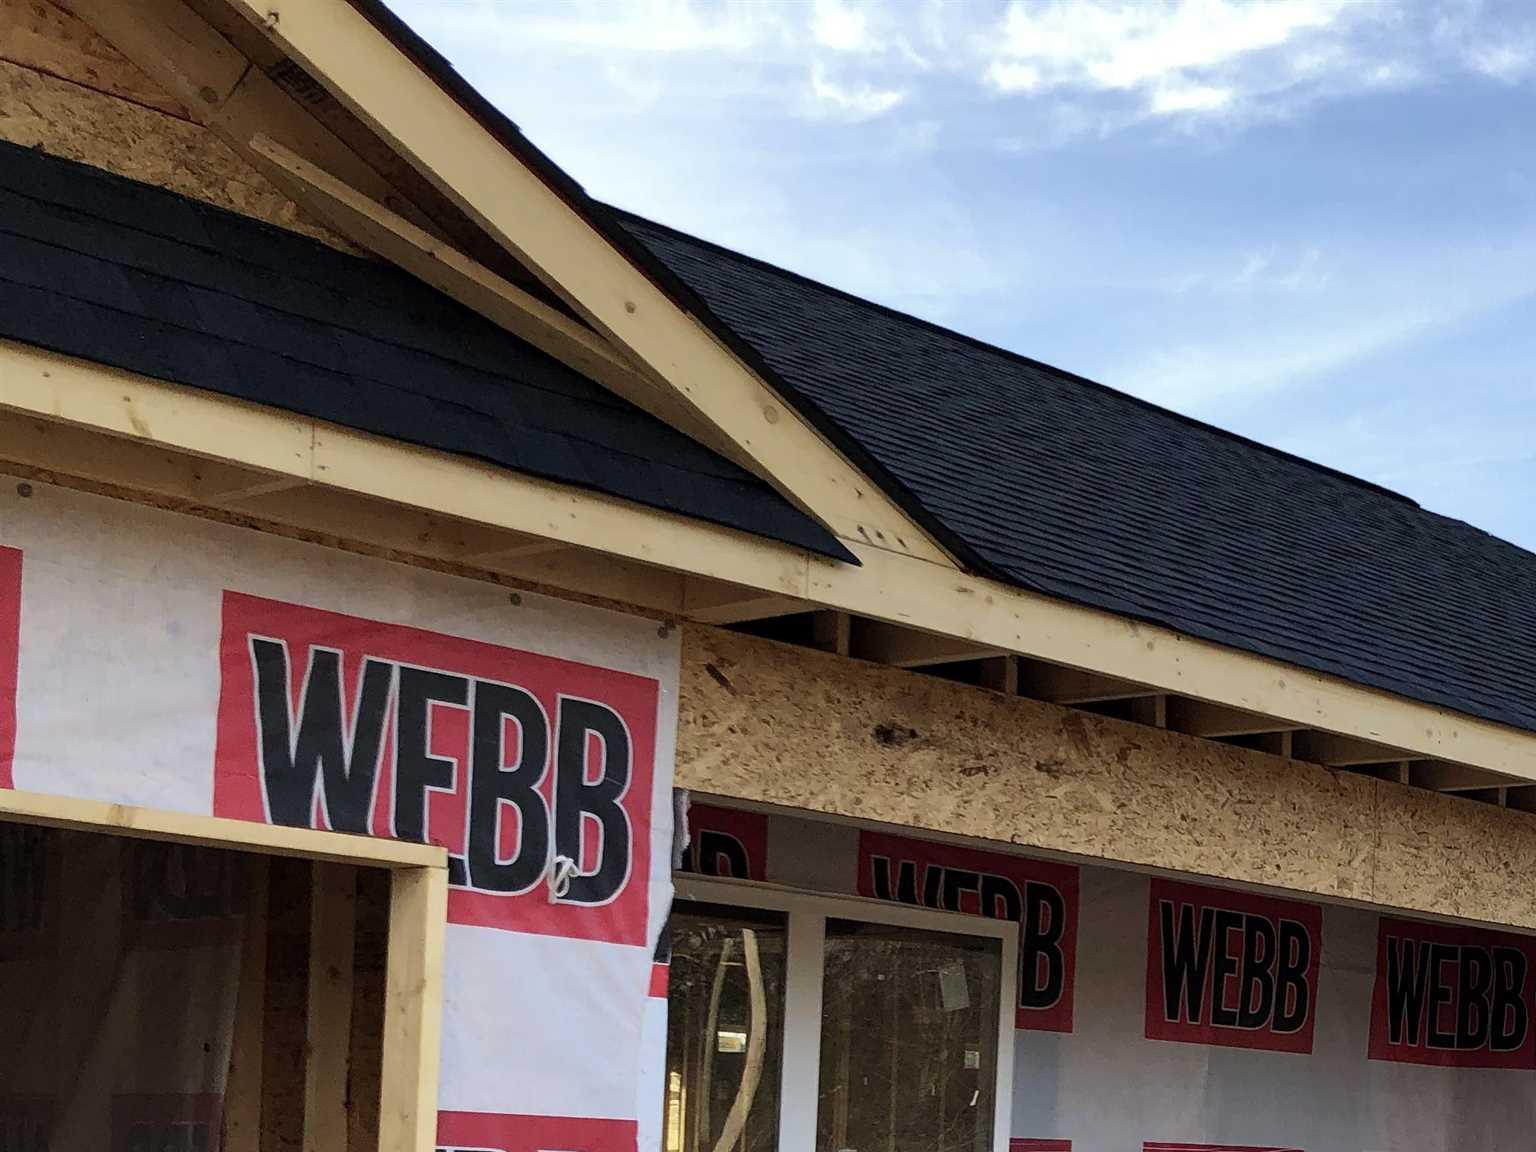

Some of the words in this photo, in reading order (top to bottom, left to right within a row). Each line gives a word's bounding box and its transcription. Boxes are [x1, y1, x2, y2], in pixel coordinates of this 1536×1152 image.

[247, 633, 633, 907] WEBB
[1158, 899, 1311, 1034] WEBB
[1386, 934, 1528, 1052] WEBB
